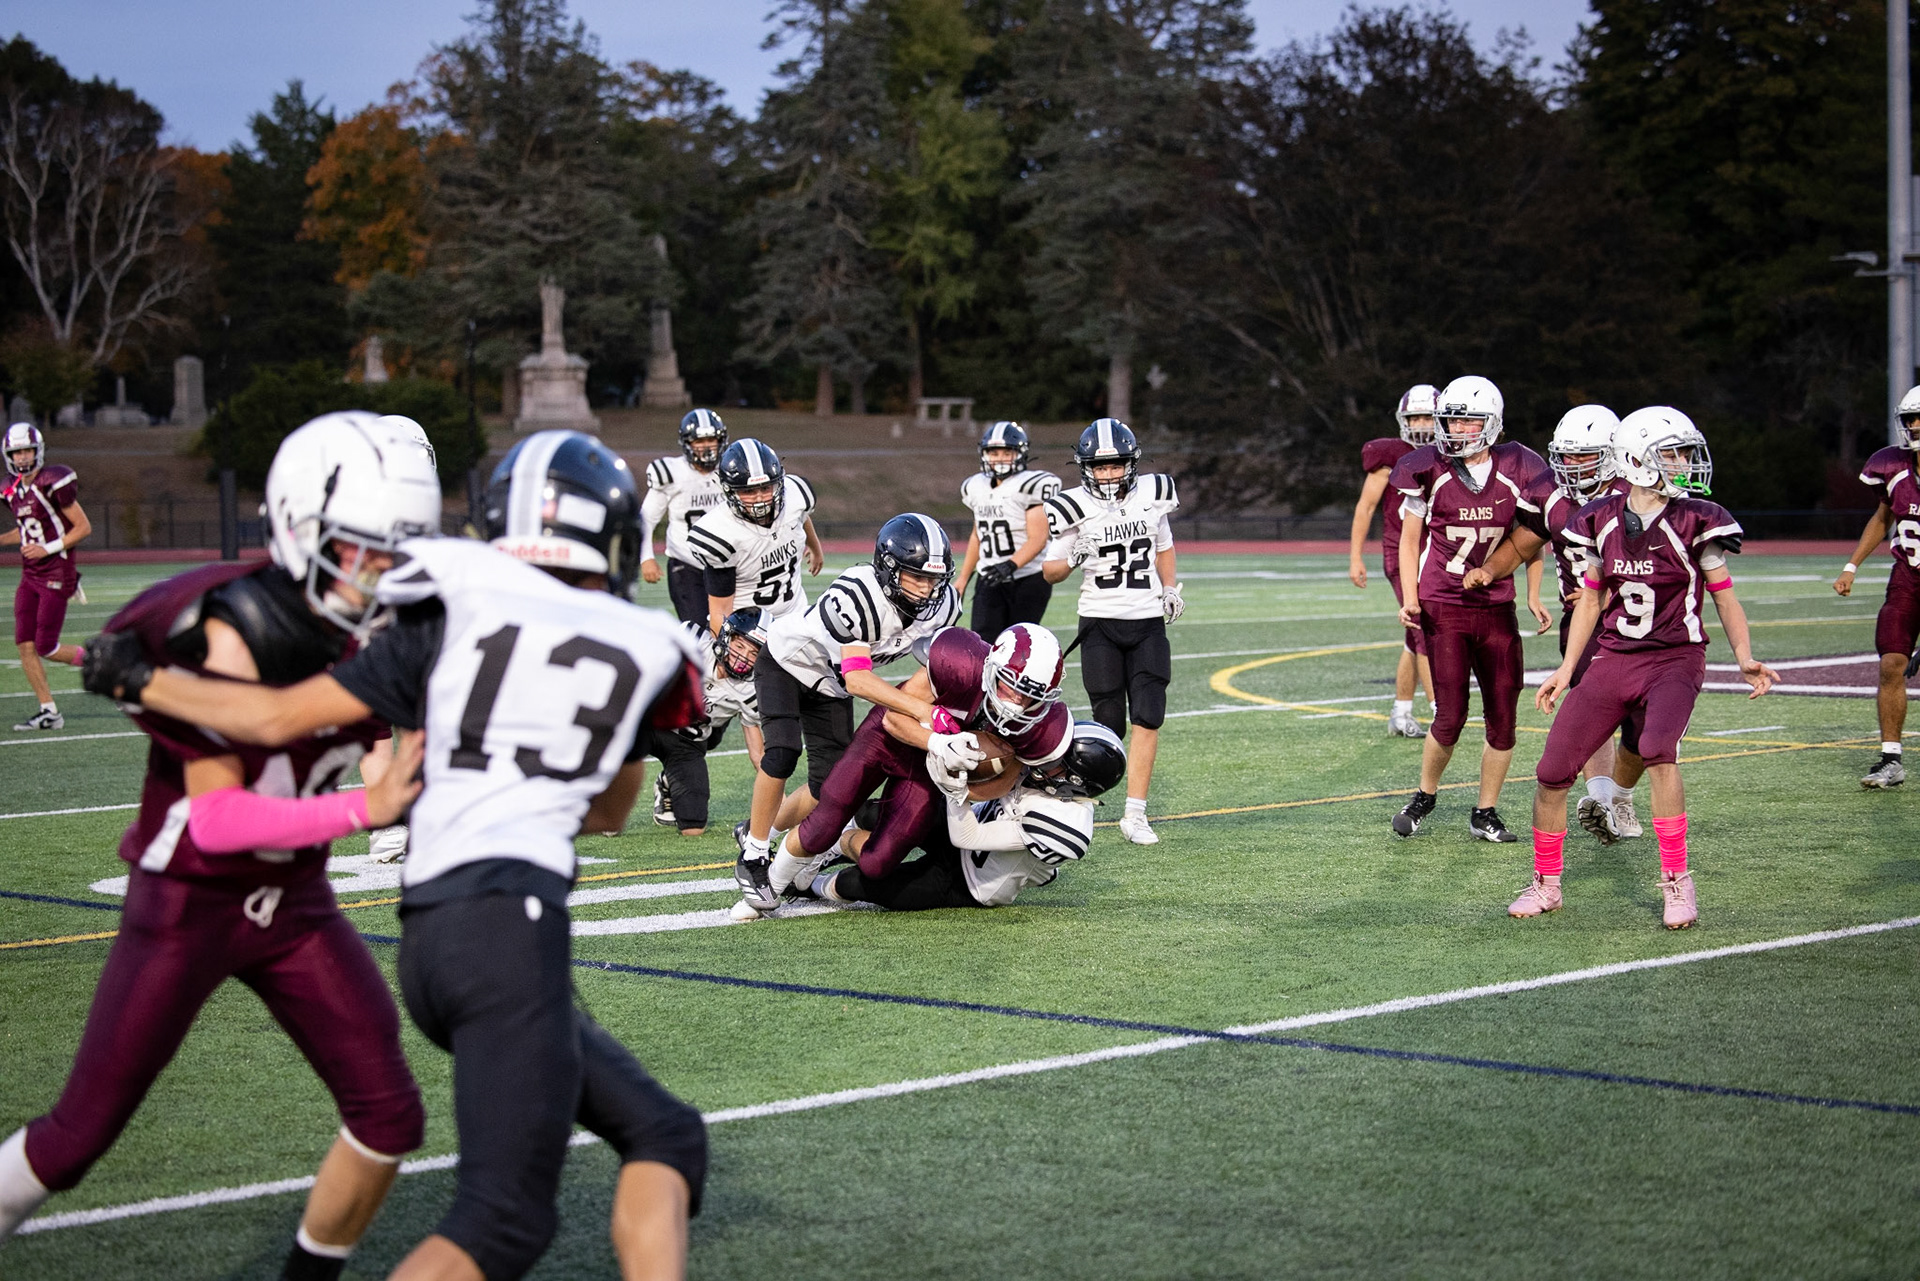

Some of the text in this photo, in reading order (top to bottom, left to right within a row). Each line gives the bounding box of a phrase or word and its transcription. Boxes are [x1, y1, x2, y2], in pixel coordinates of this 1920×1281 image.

[691, 493, 725, 507] HAWKS
[1459, 507, 1493, 521] RAMS
[1104, 520, 1148, 542] HAWKS
[1445, 525, 1505, 576] 77
[760, 539, 798, 569] HAWKS
[1094, 537, 1152, 590] 32
[1612, 558, 1654, 575] RAMS
[752, 555, 798, 606] 51
[1616, 580, 1656, 640] 9
[448, 623, 643, 782] 13
